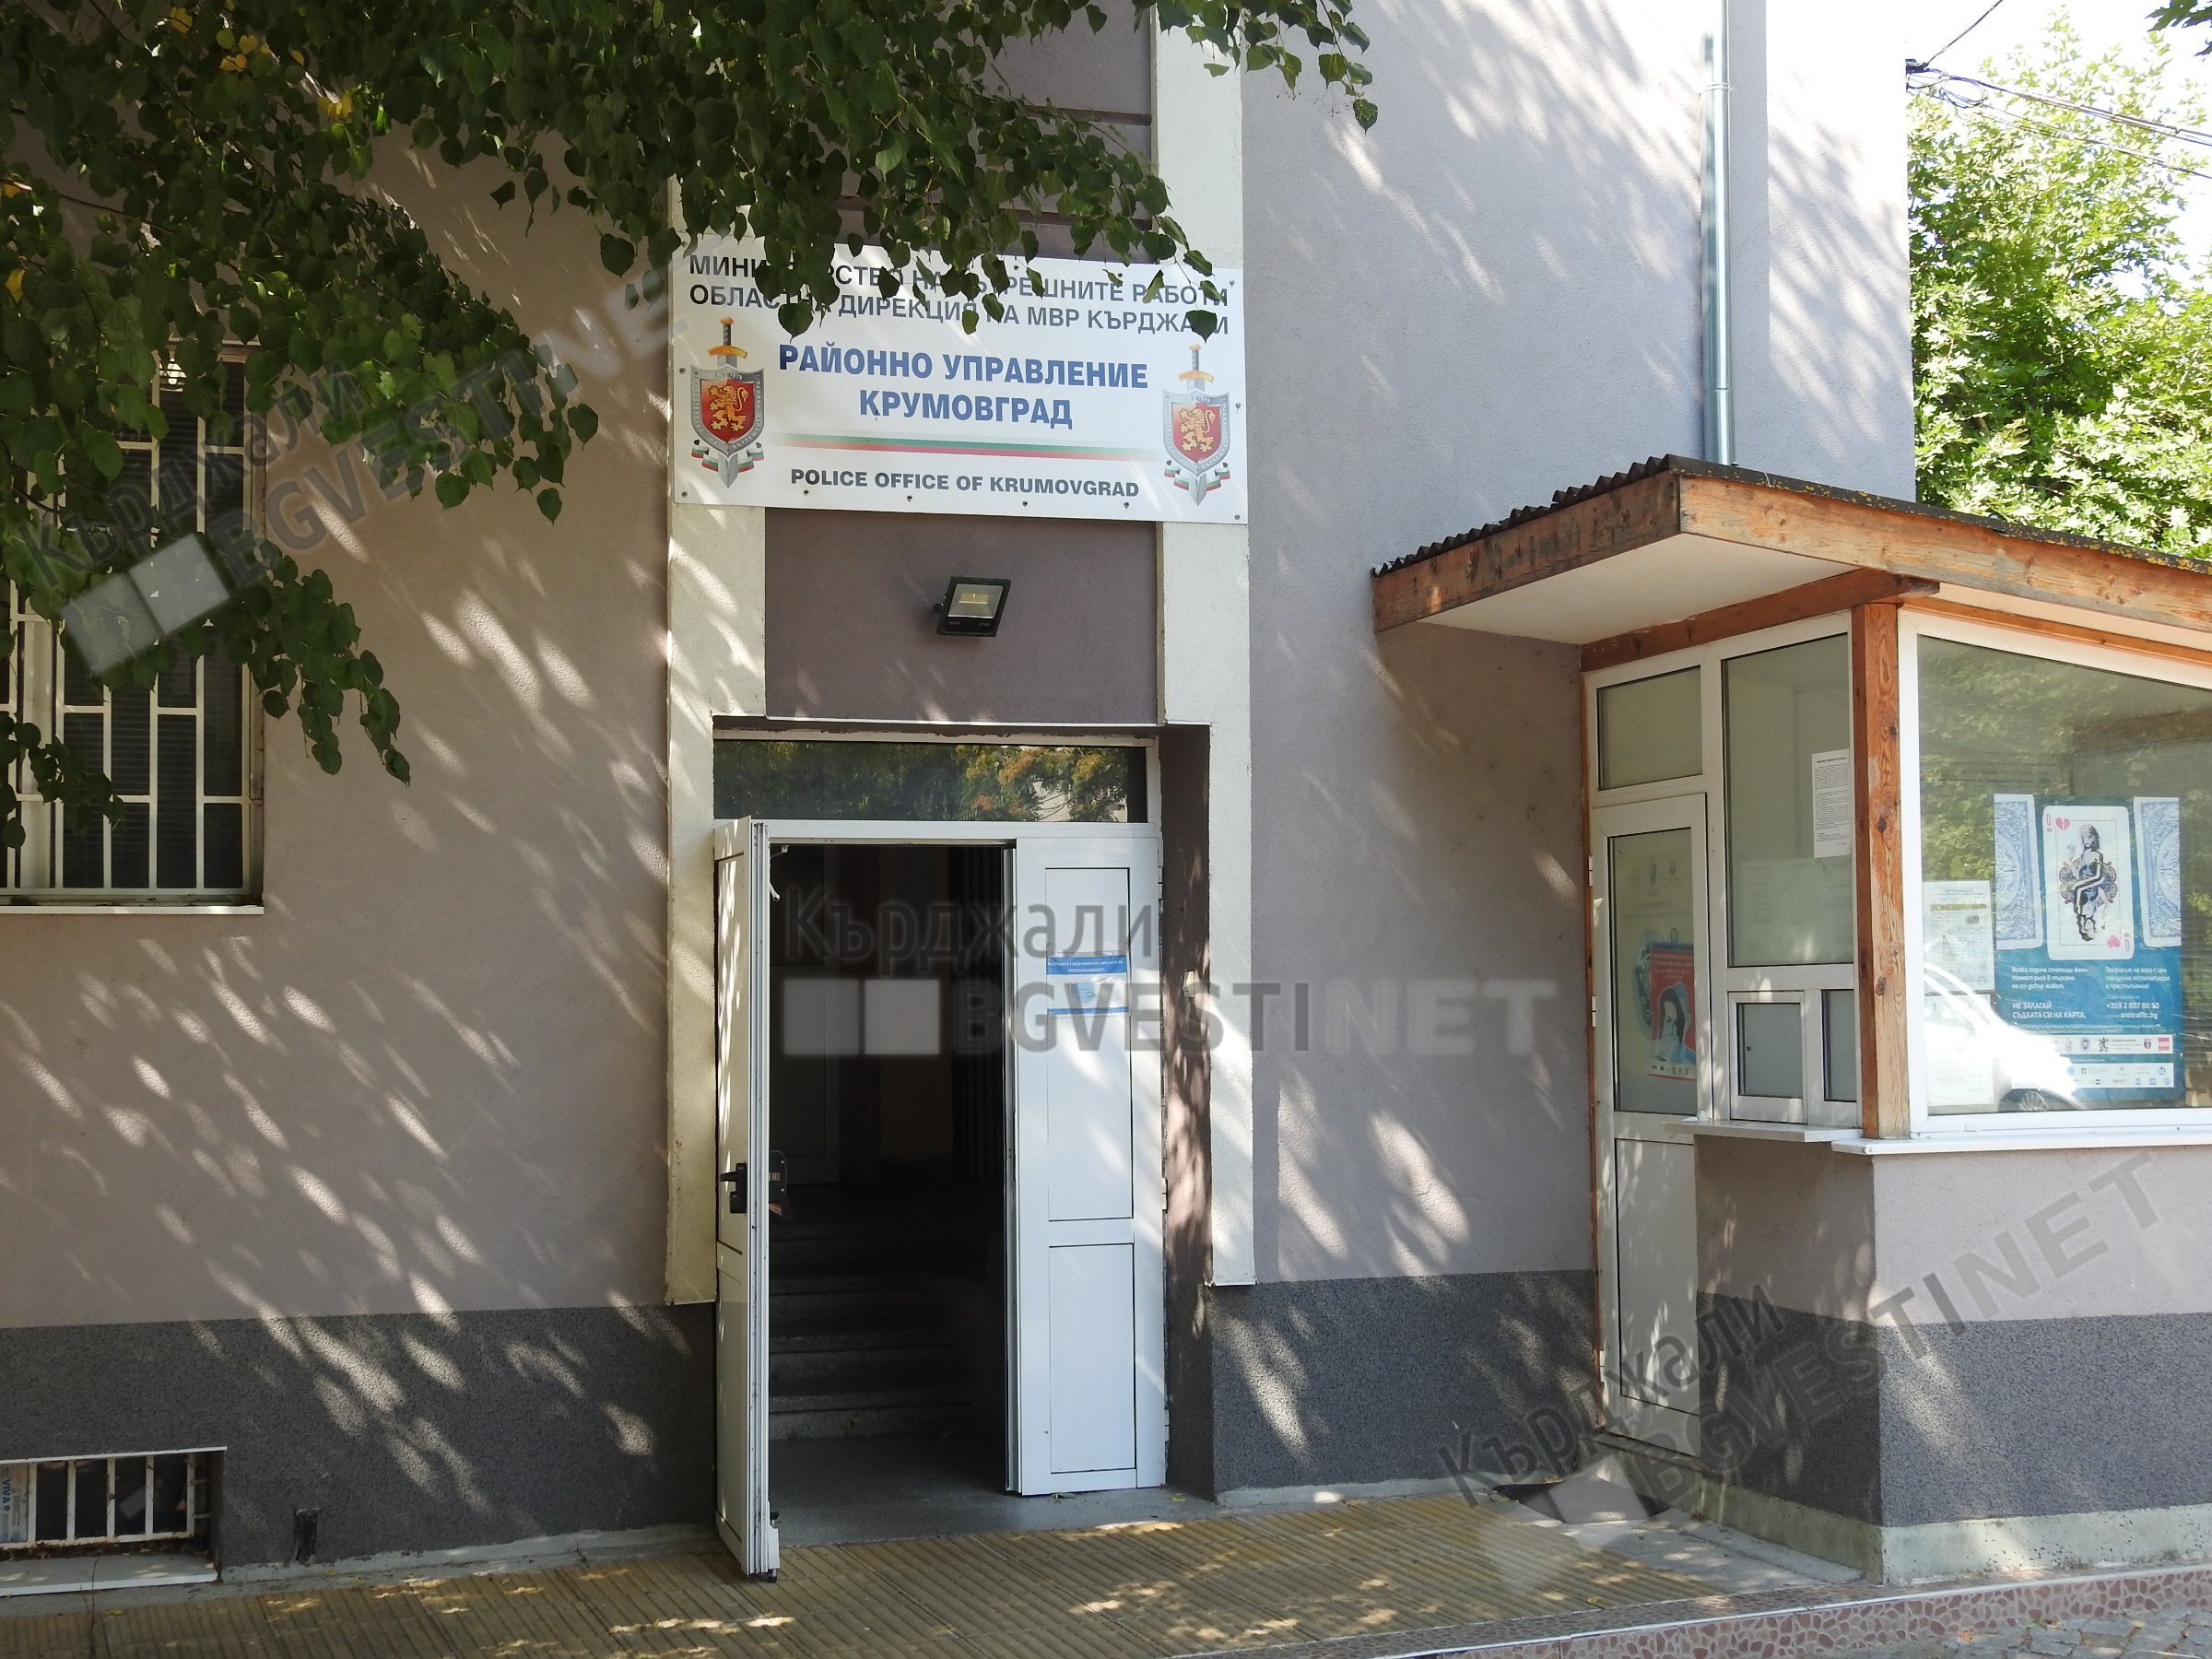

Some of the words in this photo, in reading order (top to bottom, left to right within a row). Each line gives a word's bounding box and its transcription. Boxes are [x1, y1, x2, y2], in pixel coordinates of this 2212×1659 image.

[1028, 306, 1079, 328] МВР
[1088, 310, 1229, 335] КЪРДЖАИ
[779, 341, 933, 380] РАЙОННО
[942, 354, 1148, 389] УПРАВЛЕНИЕ
[860, 390, 1073, 429] КРУМОВГРАД
[791, 468, 868, 488] POLICE
[875, 472, 949, 490] OFFICE
[956, 475, 983, 491] OF
[990, 477, 1139, 498] KRUMOVGRAD
[2012, 1011, 2042, 1019] СЪДБАТА
[2022, 1001, 2052, 1009] ЗАЛАГАЙ
[2120, 1011, 2159, 1020] antitraffic.bg
